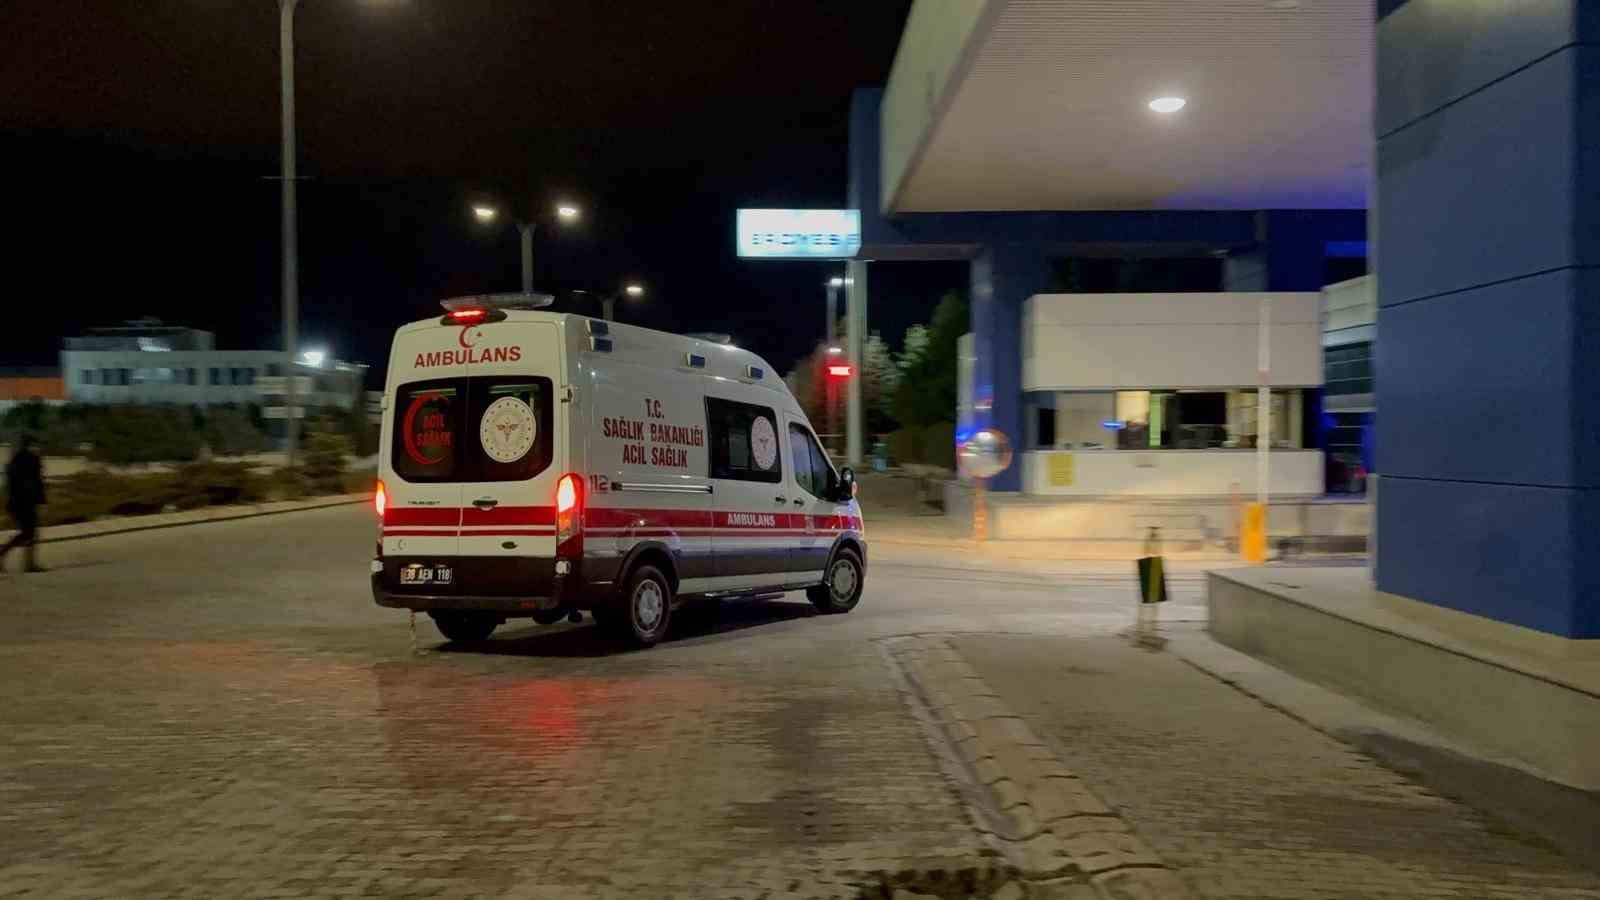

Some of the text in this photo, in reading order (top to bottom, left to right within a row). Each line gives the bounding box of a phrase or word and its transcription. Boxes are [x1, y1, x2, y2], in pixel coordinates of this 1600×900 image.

[414, 345, 522, 369] AMBULANS
[645, 398, 665, 419] T.C.
[603, 416, 704, 448] SAĞLIK BAKANLIĞI
[623, 441, 688, 468] ACİL SAĞLIK
[589, 473, 609, 492] 112
[727, 511, 776, 528] AMBULANS
